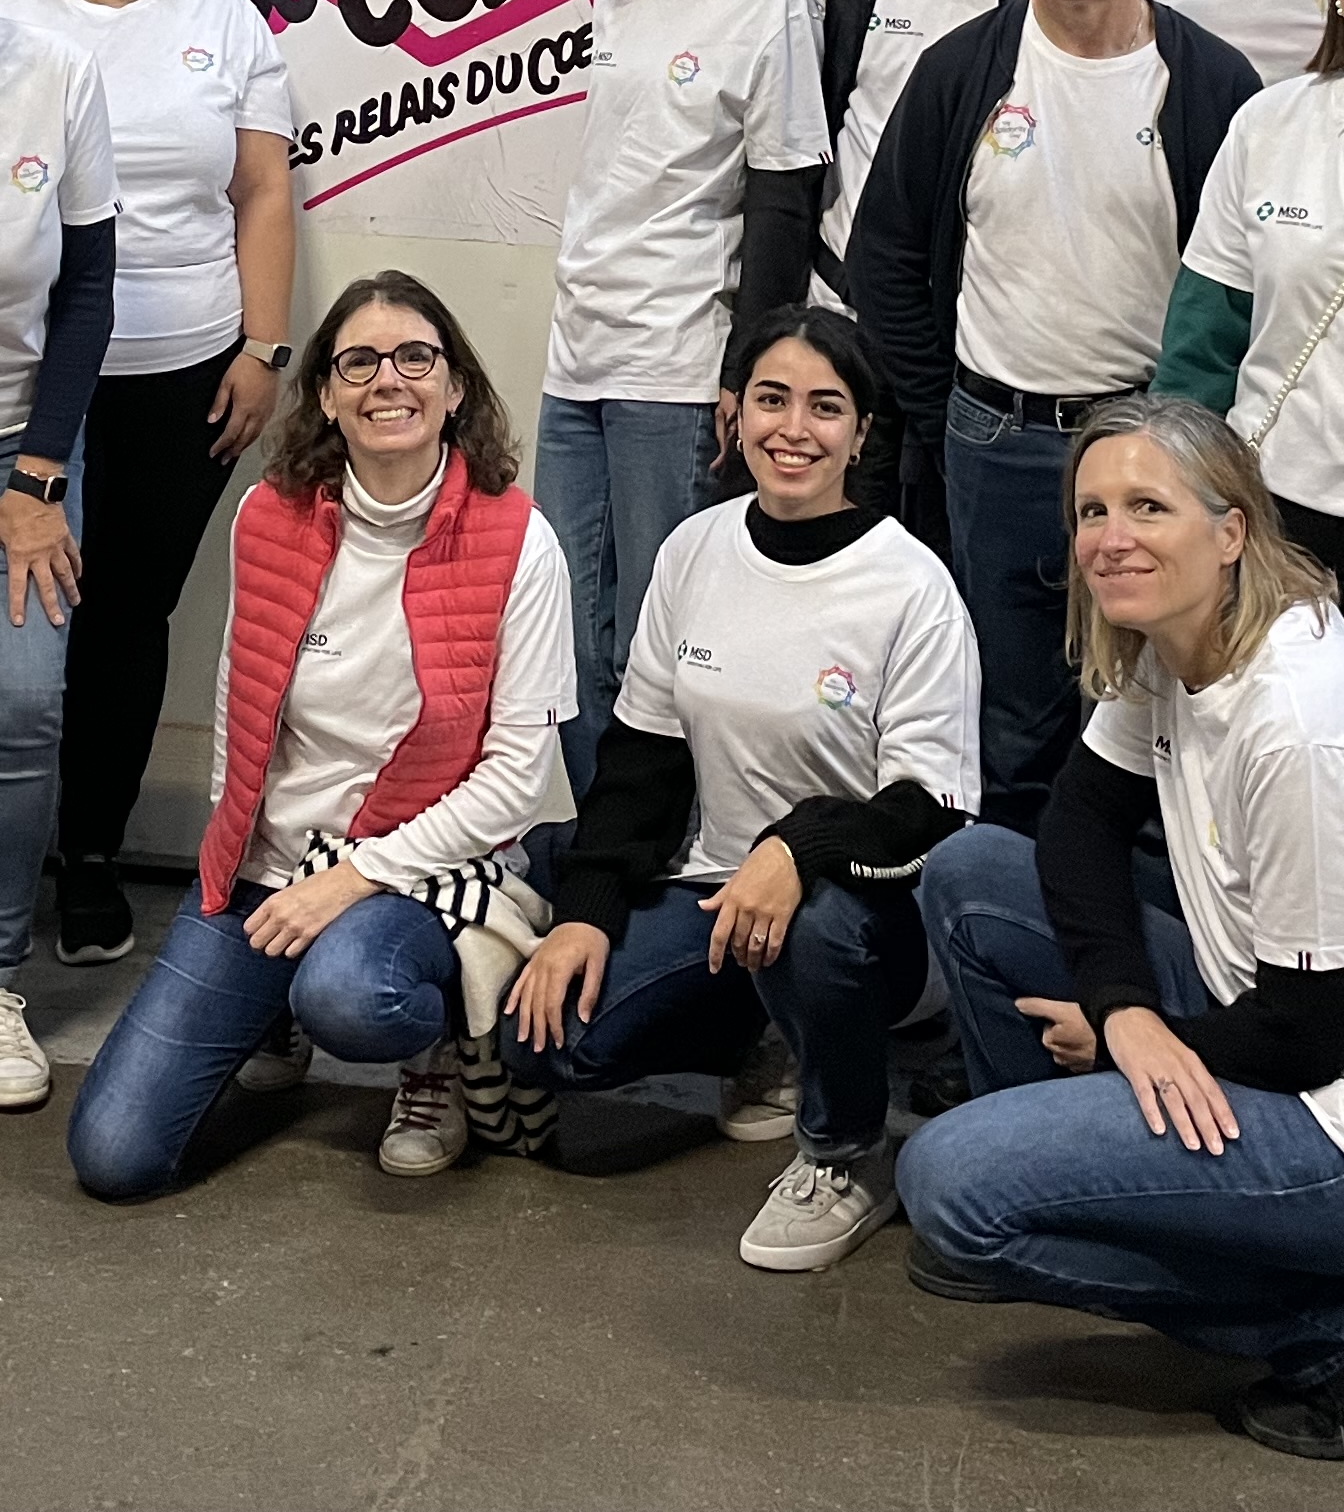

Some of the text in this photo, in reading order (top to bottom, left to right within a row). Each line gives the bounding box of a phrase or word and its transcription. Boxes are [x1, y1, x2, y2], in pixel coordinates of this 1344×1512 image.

[885, 18, 912, 30] MSD
[331, 72, 459, 156] RELAIS
[467, 52, 523, 105] DU
[1278, 206, 1309, 220] MSD
[689, 646, 712, 662] MSD
